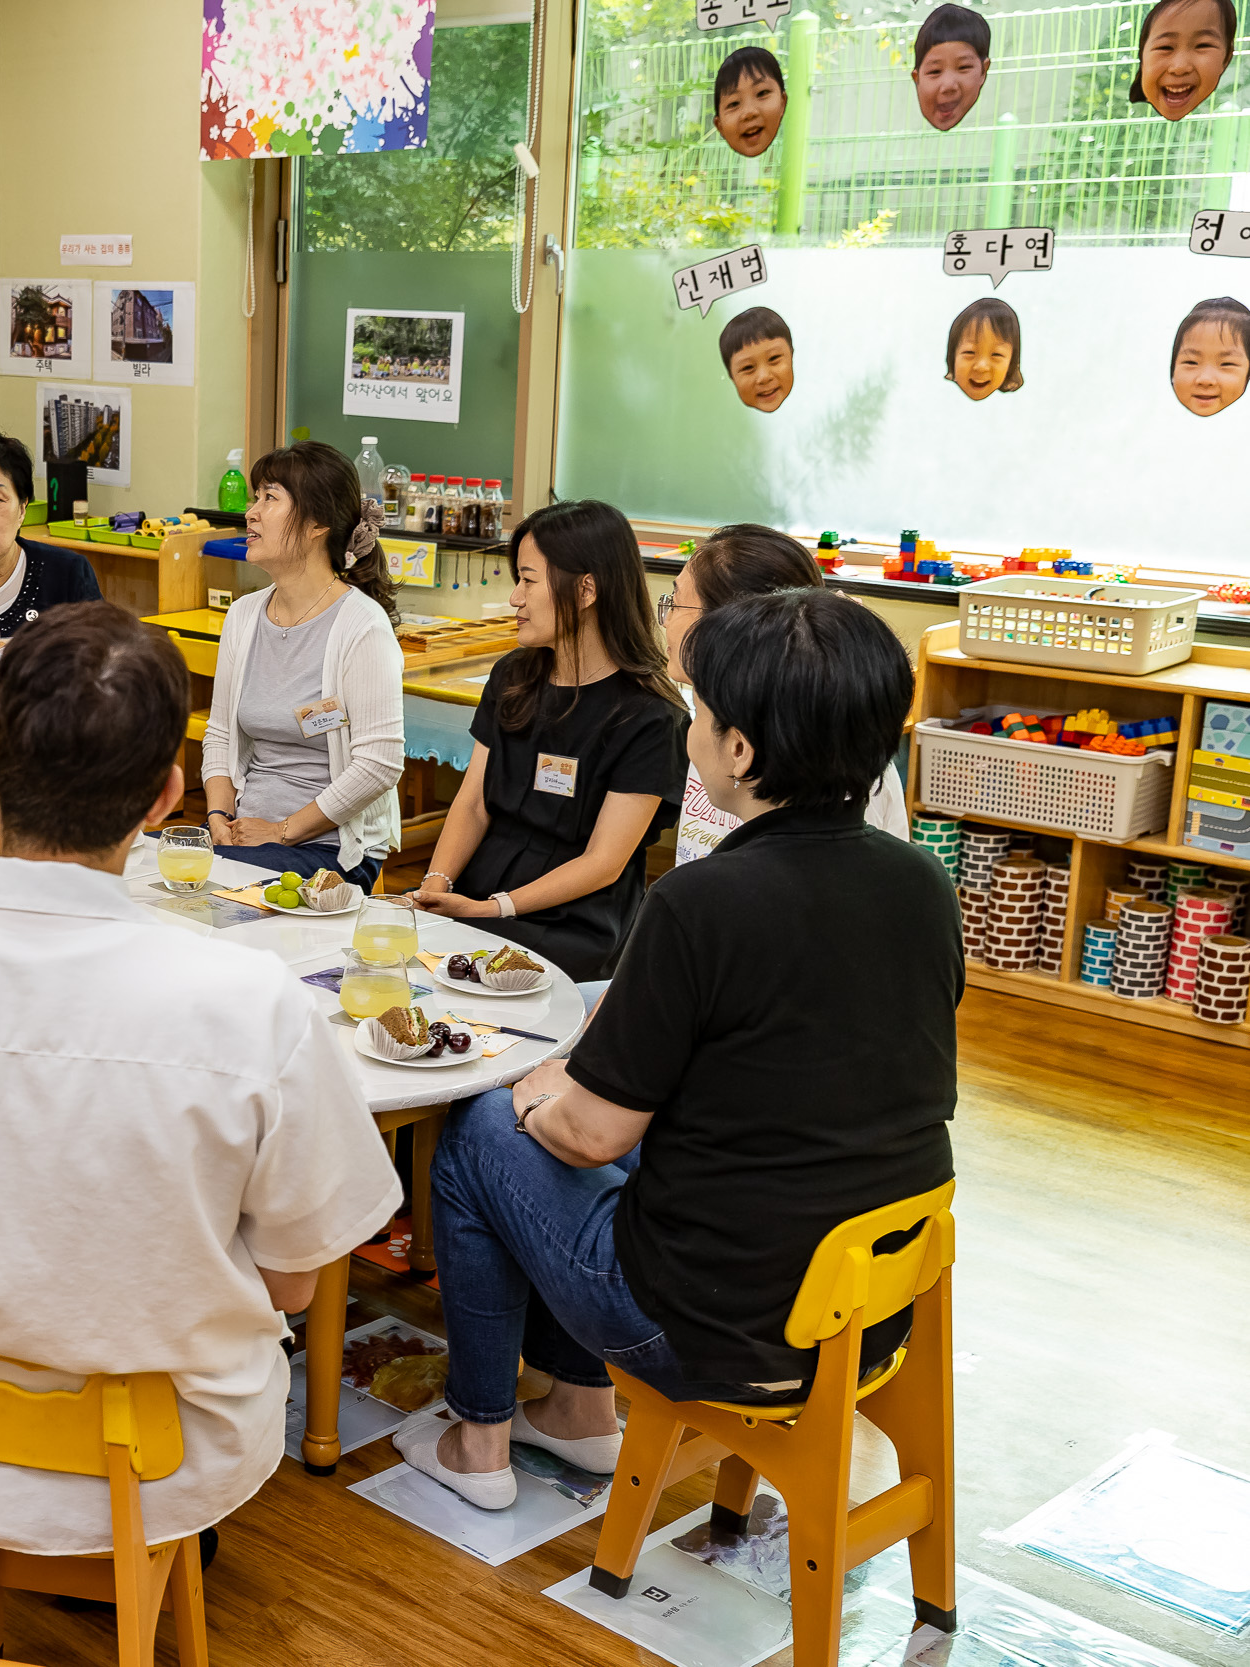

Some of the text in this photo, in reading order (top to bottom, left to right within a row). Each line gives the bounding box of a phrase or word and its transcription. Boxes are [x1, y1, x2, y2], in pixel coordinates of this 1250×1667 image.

[62, 243, 130, 255] 우리가 사는 집의 종류
[678, 248, 763, 302] 신재범
[35, 360, 53, 373] 주택
[132, 363, 151, 377] 빌라
[347, 382, 453, 404] 아차산에서 왔어요
